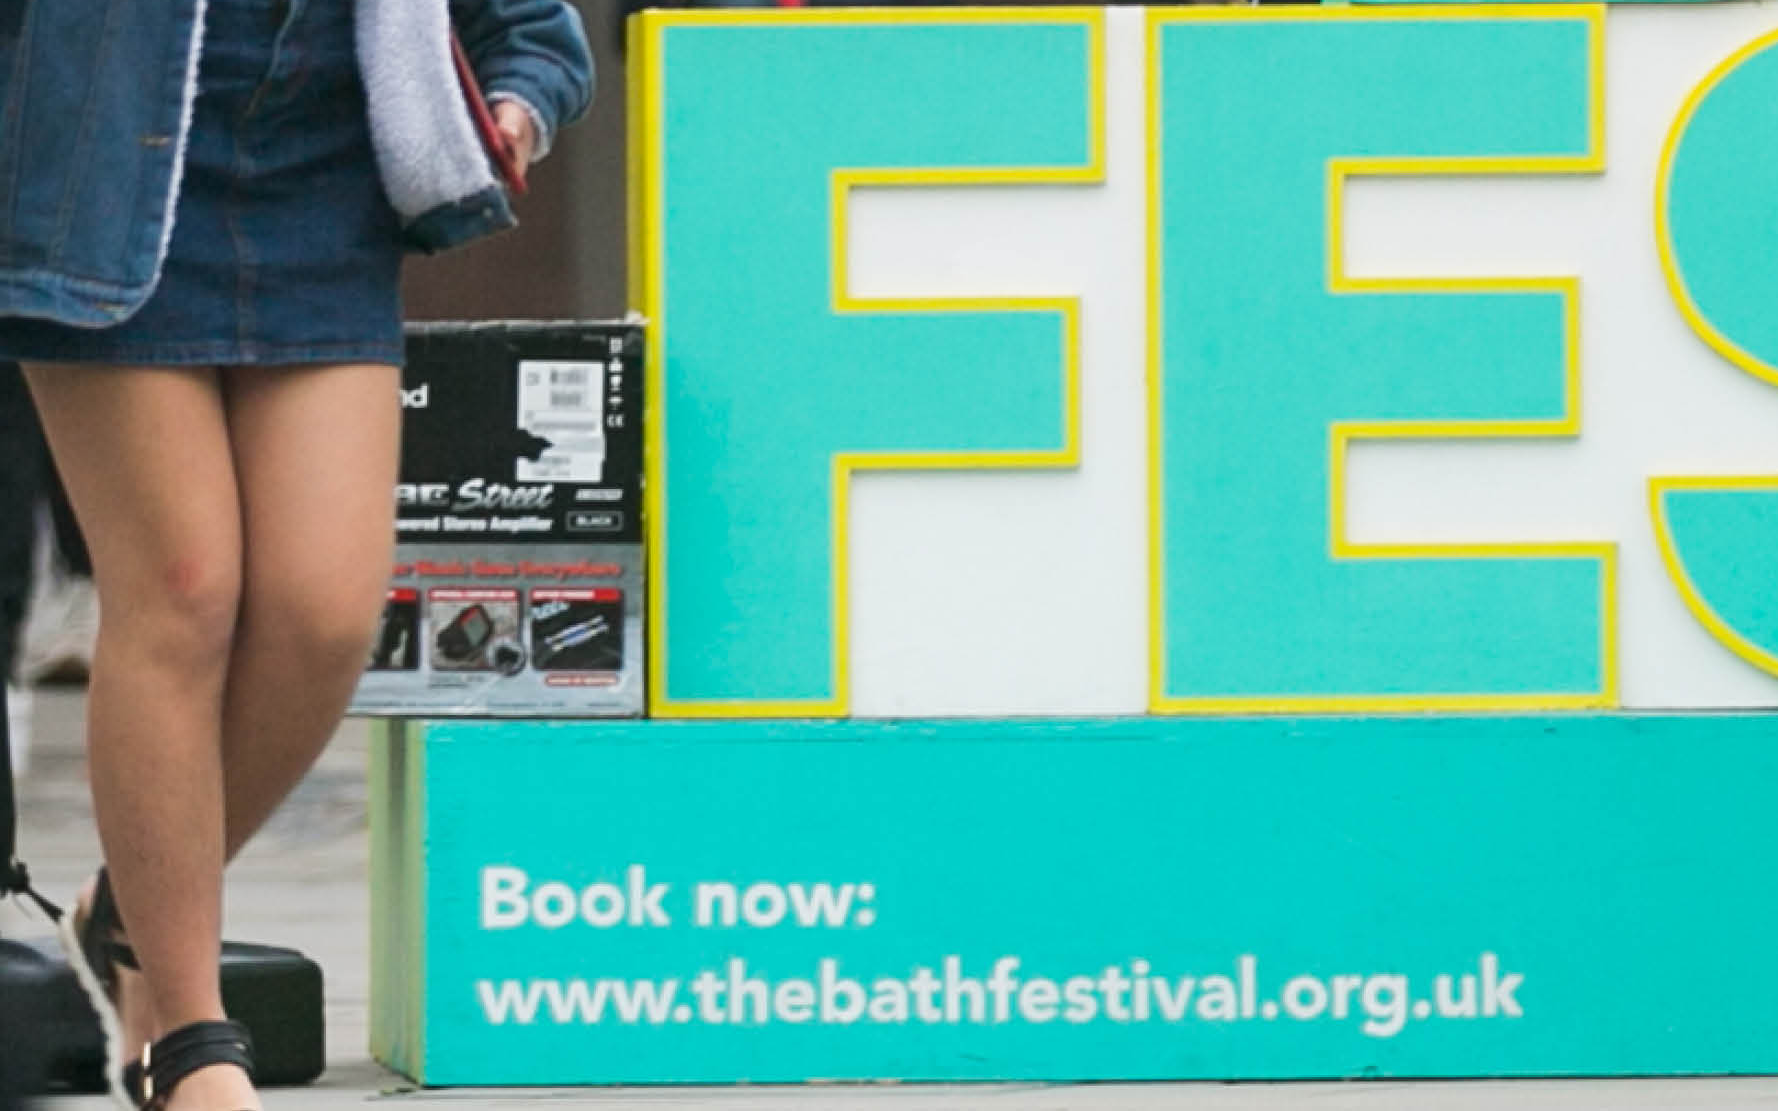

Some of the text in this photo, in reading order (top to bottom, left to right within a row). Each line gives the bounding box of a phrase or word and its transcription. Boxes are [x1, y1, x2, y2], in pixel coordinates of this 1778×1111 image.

[478, 864, 877, 931] Book now:
[476, 954, 1524, 1037] www.thebathfestival.org.uk
